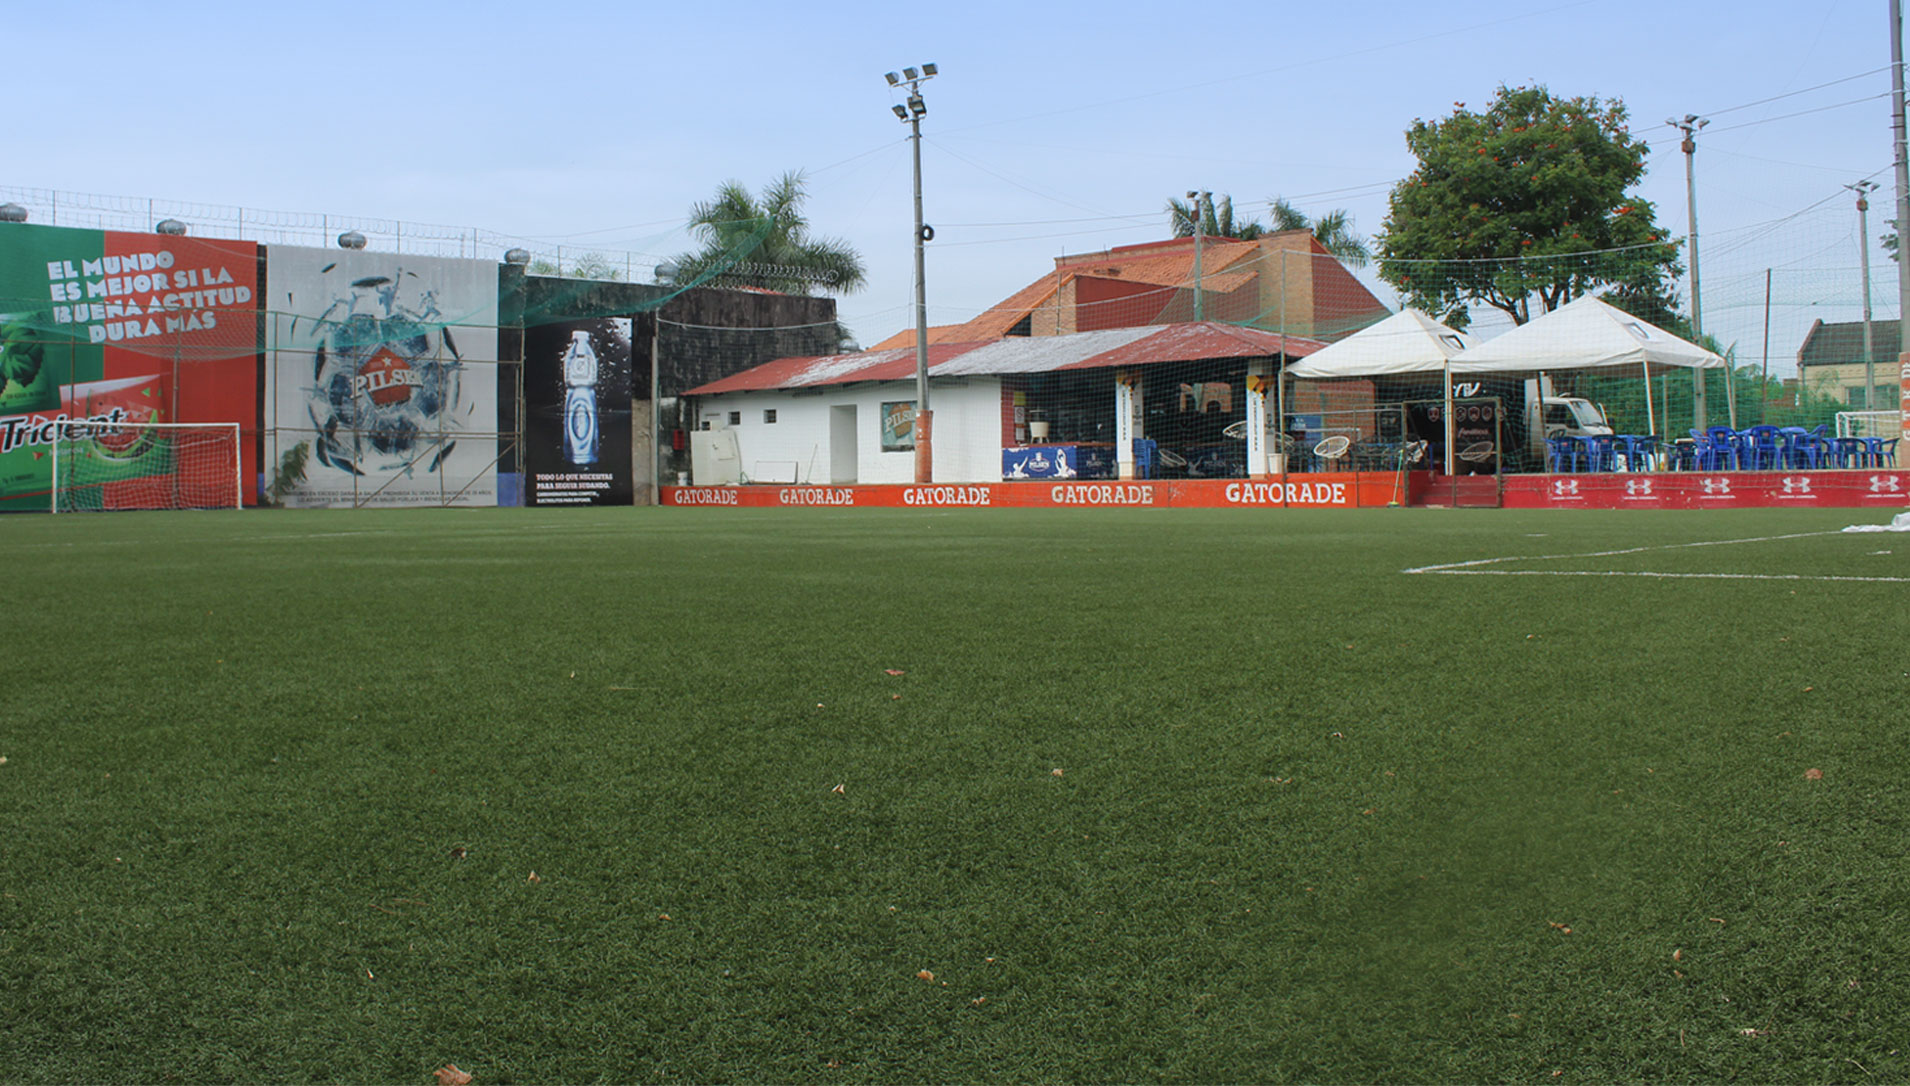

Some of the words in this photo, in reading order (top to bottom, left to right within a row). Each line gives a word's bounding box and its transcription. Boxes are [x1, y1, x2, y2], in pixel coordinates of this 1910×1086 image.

[47, 260, 79, 280] EL
[82, 250, 175, 277] MUNDO
[50, 281, 82, 302] ES
[86, 272, 170, 298] MEJOR
[173, 269, 198, 288] SI
[202, 266, 234, 286] LA
[53, 298, 143, 325] BUENA
[146, 286, 251, 314] ACTITUD
[88, 318, 162, 344] DURA
[165, 308, 217, 334] MÁS
[0, 407, 126, 453] Trident
[565, 473, 578, 481] QUE
[675, 489, 738, 505] GATORADE
[779, 487, 854, 505] GATORADE
[903, 487, 990, 505] GATORADE
[1051, 485, 1153, 505] GATORADE
[1225, 483, 1346, 503] GATORADE
